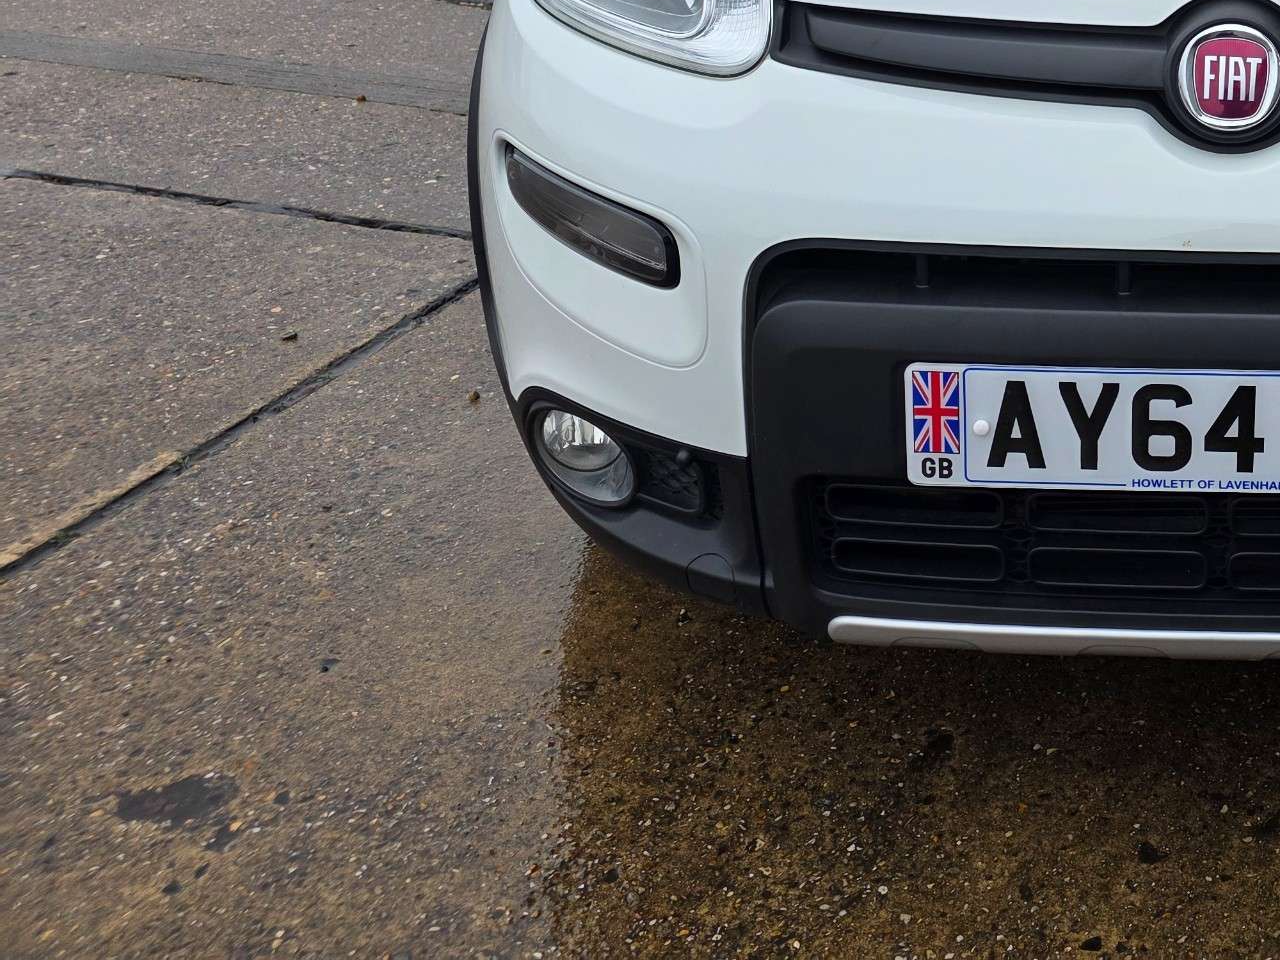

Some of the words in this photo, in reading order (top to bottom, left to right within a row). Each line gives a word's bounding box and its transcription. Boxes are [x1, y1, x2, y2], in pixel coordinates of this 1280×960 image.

[1203, 55, 1262, 102] FIAT
[986, 380, 1264, 473] AY64
[921, 457, 954, 479] GB
[1131, 478, 1194, 489] HOWLETT
[1197, 479, 1215, 490] OF
